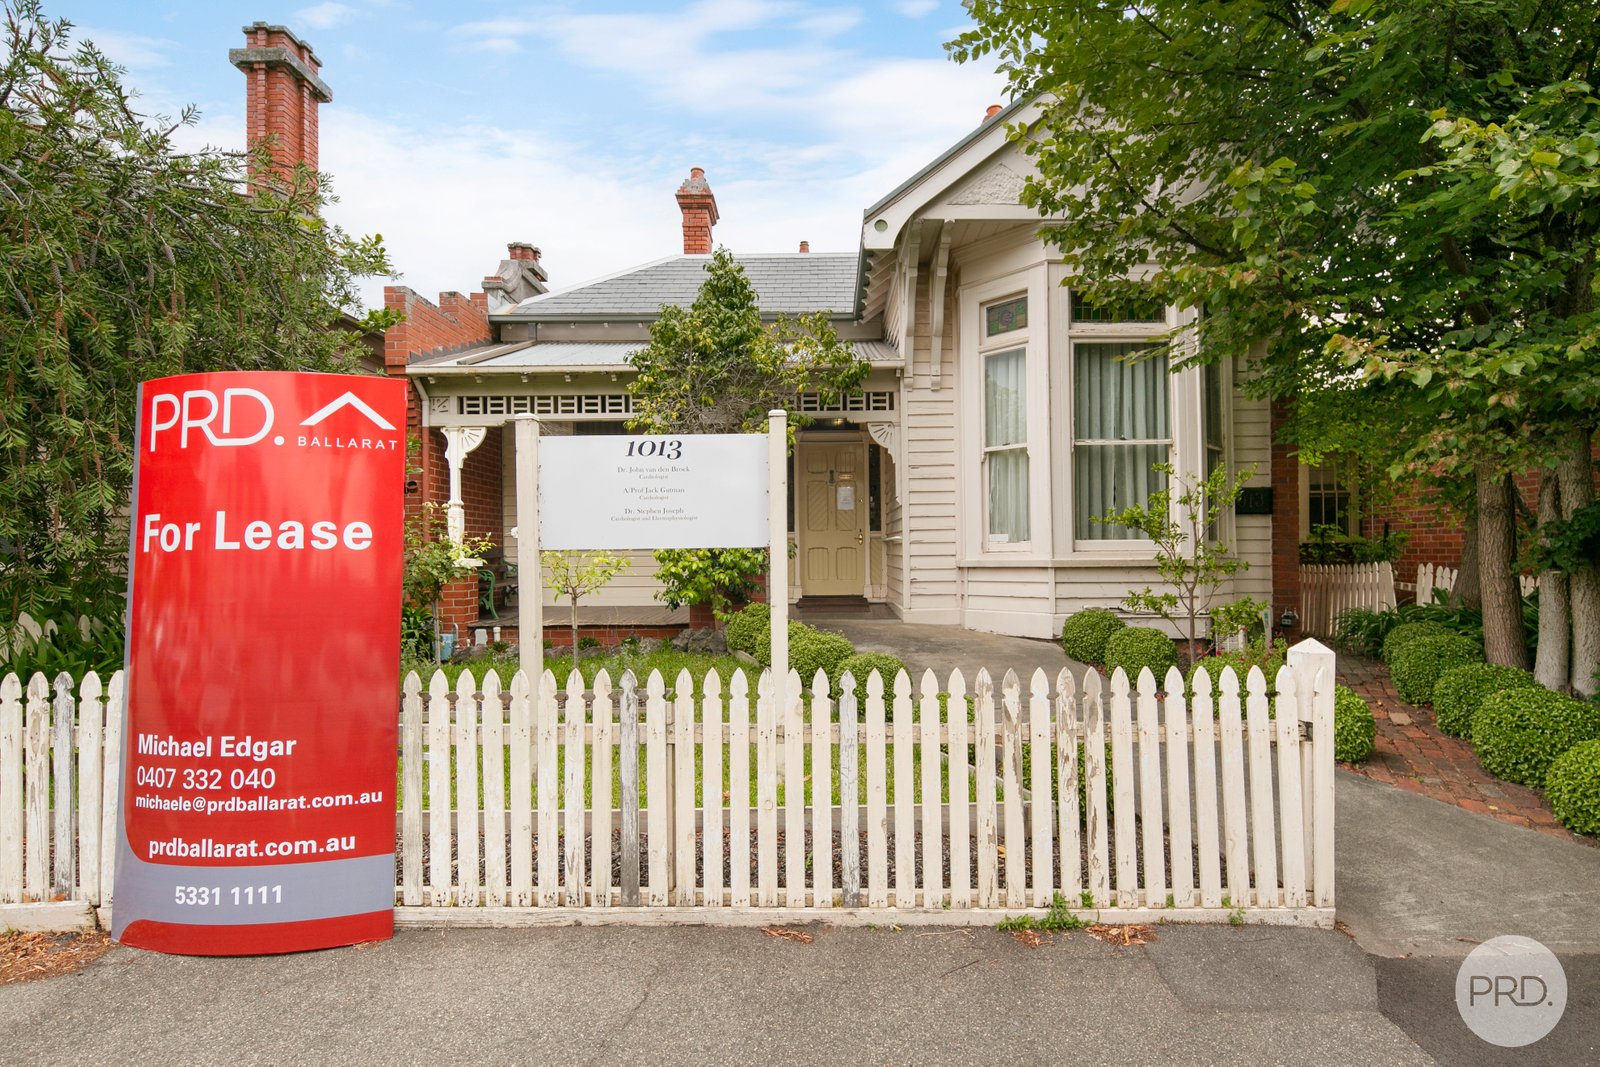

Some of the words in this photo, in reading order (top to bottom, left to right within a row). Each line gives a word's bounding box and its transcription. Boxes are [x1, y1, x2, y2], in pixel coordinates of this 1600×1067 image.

[297, 436, 398, 450] BALLARAT
[625, 440, 683, 460] 1013
[628, 466, 644, 474] John
[636, 507, 662, 515] Stephen
[663, 507, 685, 515] Joseph
[143, 513, 201, 553] For
[214, 510, 373, 550] Lease
[137, 733, 212, 757] Michael
[220, 735, 297, 762] Edgar
[136, 765, 176, 788] 0407
[182, 768, 222, 790] 332
[230, 767, 276, 789] 040
[135, 791, 383, 815] michaele@prdballarat.com.au
[148, 835, 356, 859] prdballarat.com.au
[174, 885, 221, 905] 5331
[230, 885, 282, 905] 1111
